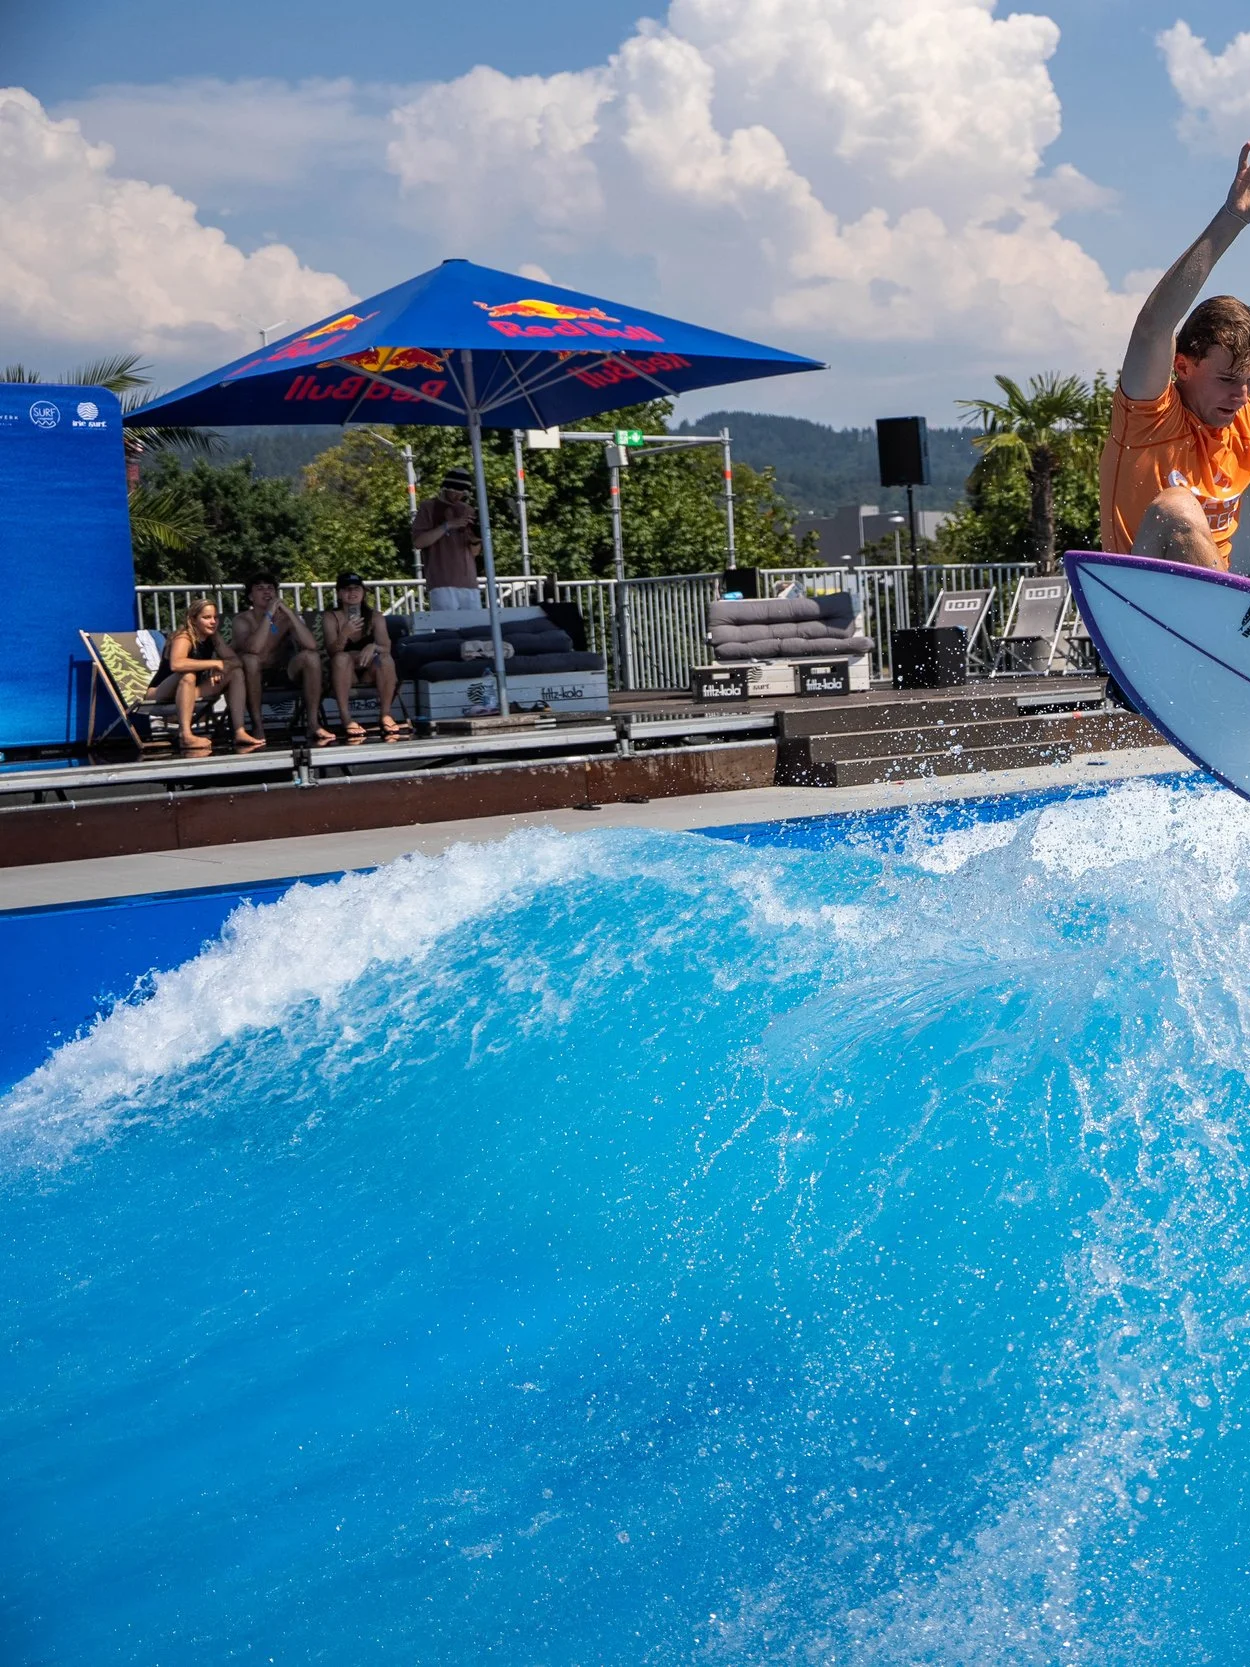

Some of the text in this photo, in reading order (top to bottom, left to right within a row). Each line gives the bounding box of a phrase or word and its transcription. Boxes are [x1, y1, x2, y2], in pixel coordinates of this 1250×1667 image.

[487, 320, 665, 343] Red Bull
[33, 407, 56, 418] SURF
[702, 684, 741, 697] fritz-kola
[806, 677, 843, 691] fritz-kola
[541, 687, 584, 701] fritz-kola
